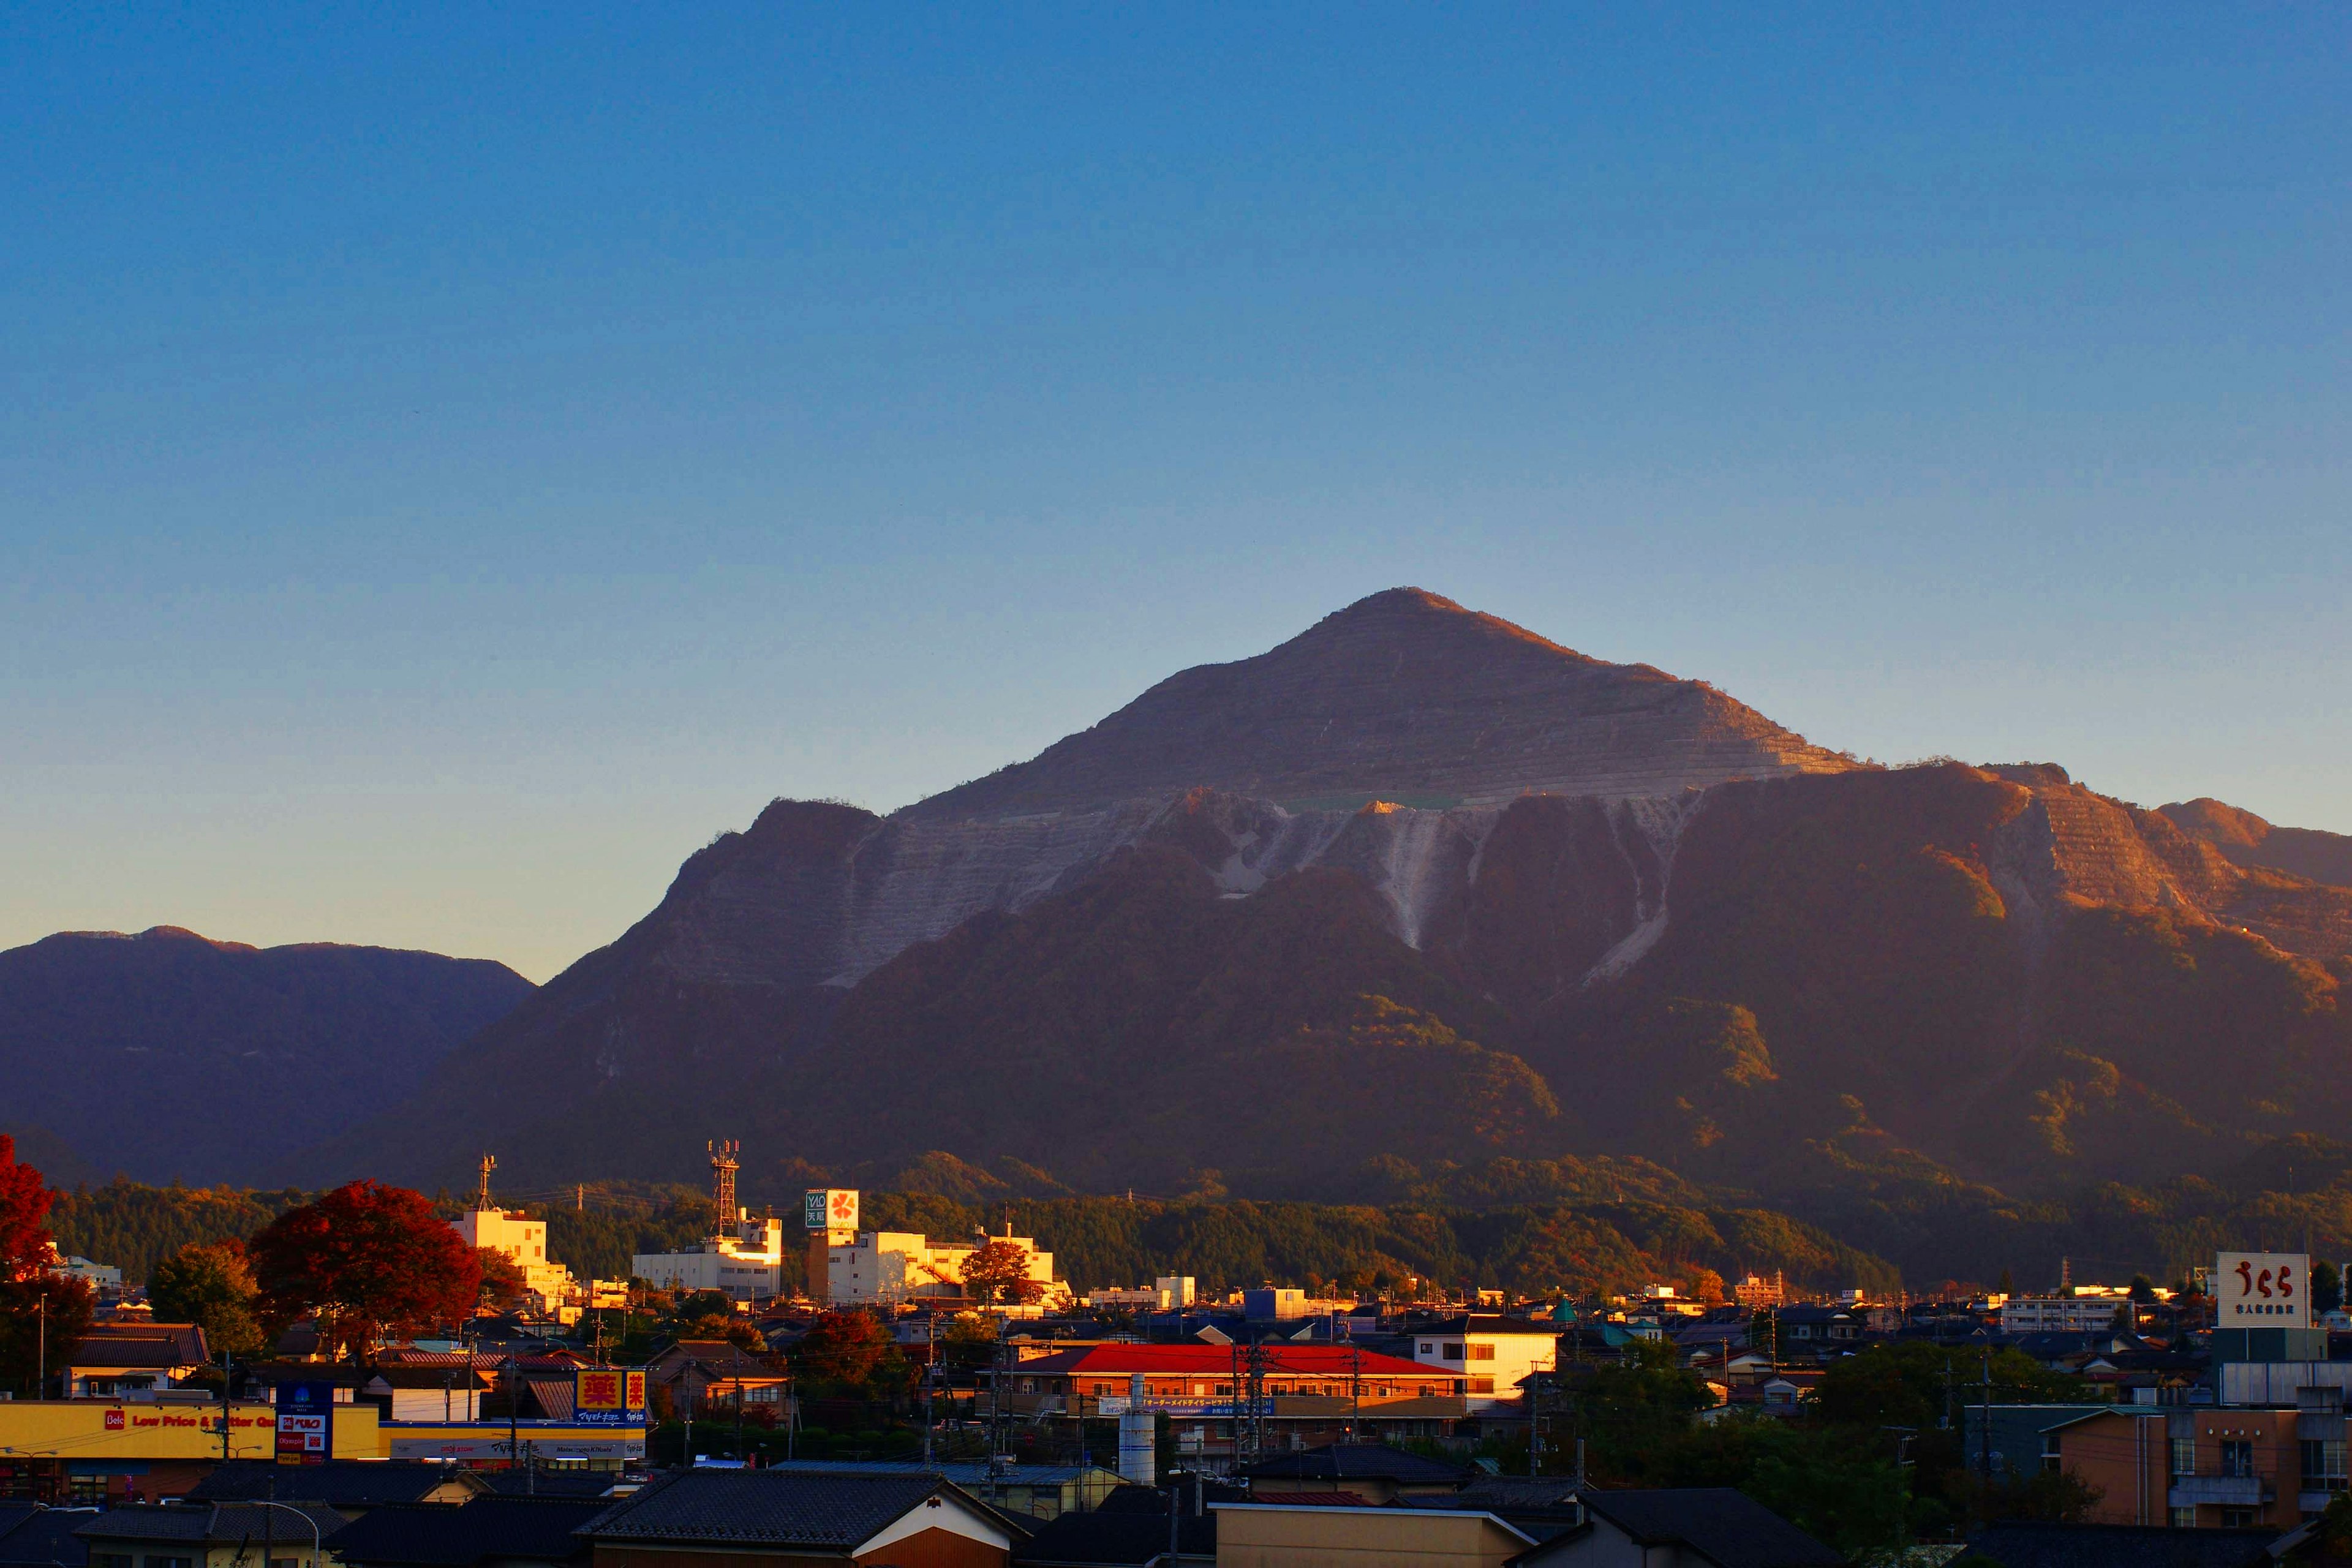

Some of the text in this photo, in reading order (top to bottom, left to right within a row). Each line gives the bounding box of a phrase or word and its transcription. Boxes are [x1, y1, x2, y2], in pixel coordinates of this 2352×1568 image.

[808, 1196, 826, 1207] YAO
[584, 1374, 616, 1405] 薬
[630, 1374, 643, 1405] 薬
[107, 1414, 124, 1425] Belc
[133, 1416, 159, 1426] Low
[163, 1415, 196, 1427] Price
[200, 1416, 209, 1427] &
